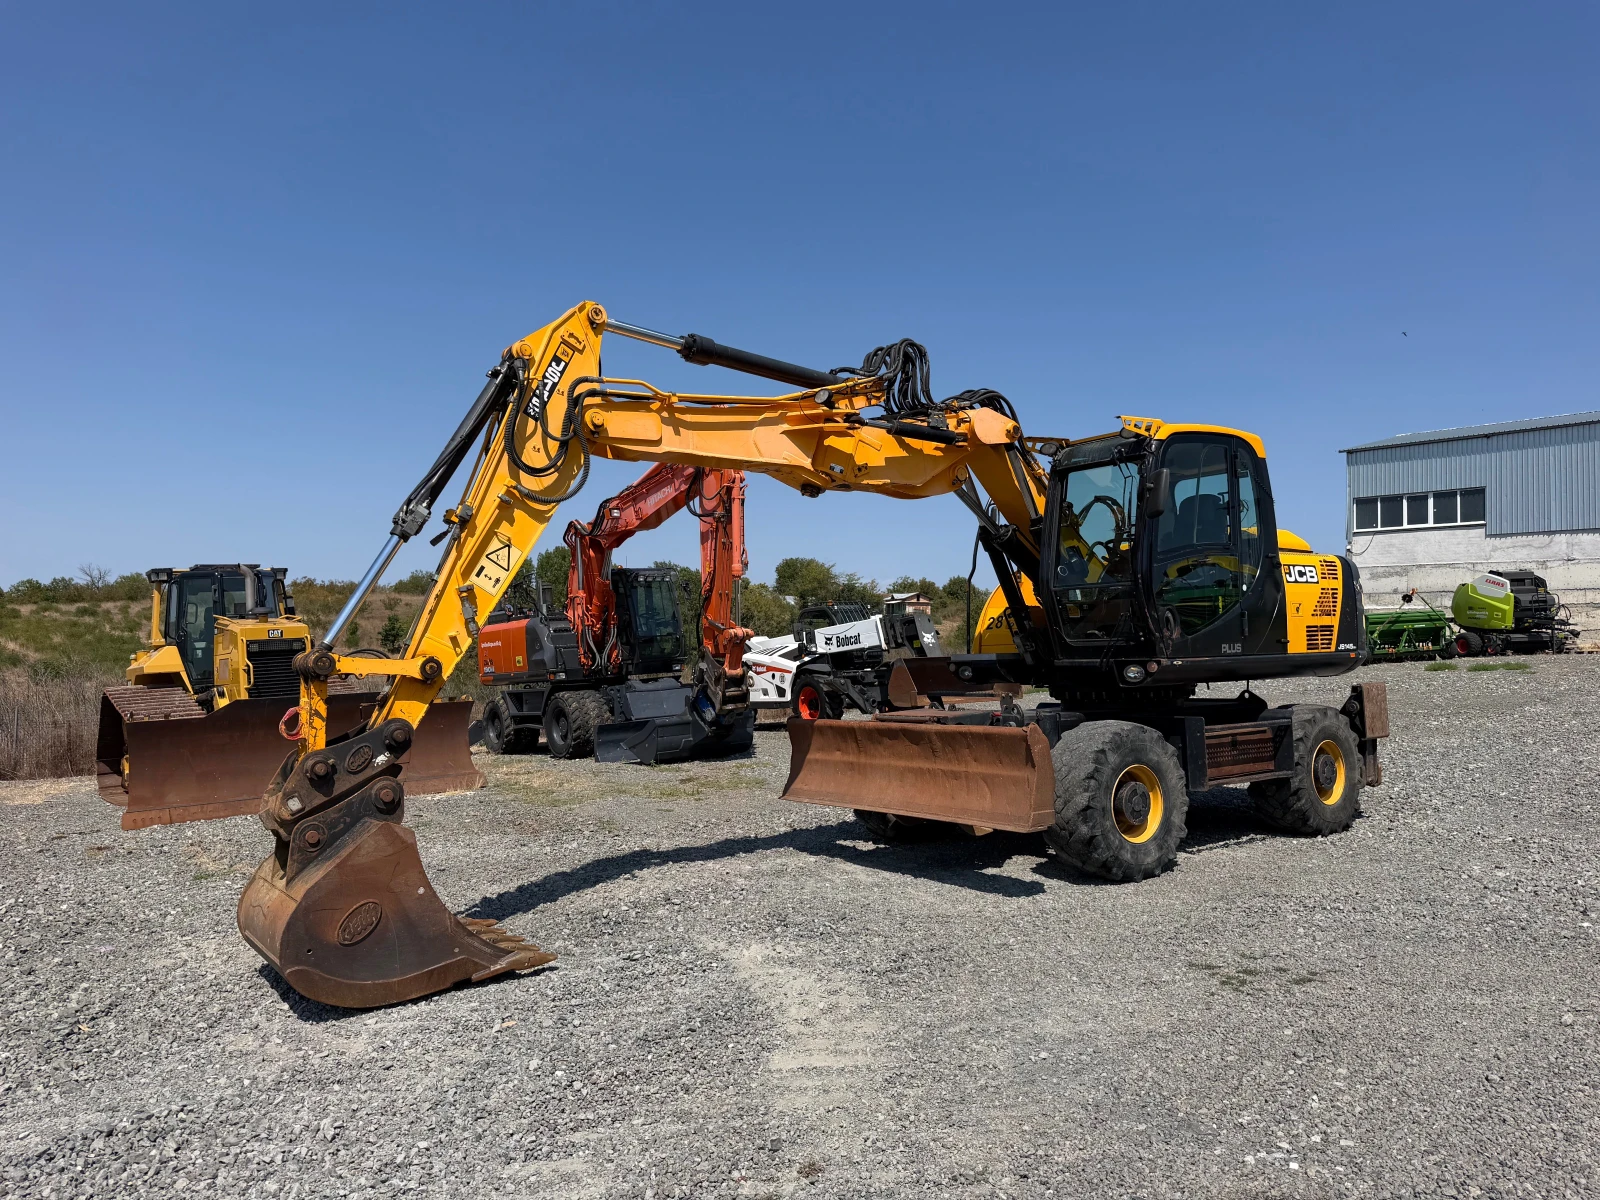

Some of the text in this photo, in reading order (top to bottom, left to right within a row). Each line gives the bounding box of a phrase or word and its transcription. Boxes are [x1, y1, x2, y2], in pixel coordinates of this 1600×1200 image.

[1286, 566, 1318, 582] JCB
[269, 630, 281, 638] CAT
[836, 633, 861, 648] Bobcat
[1222, 643, 1242, 653] PLUS
